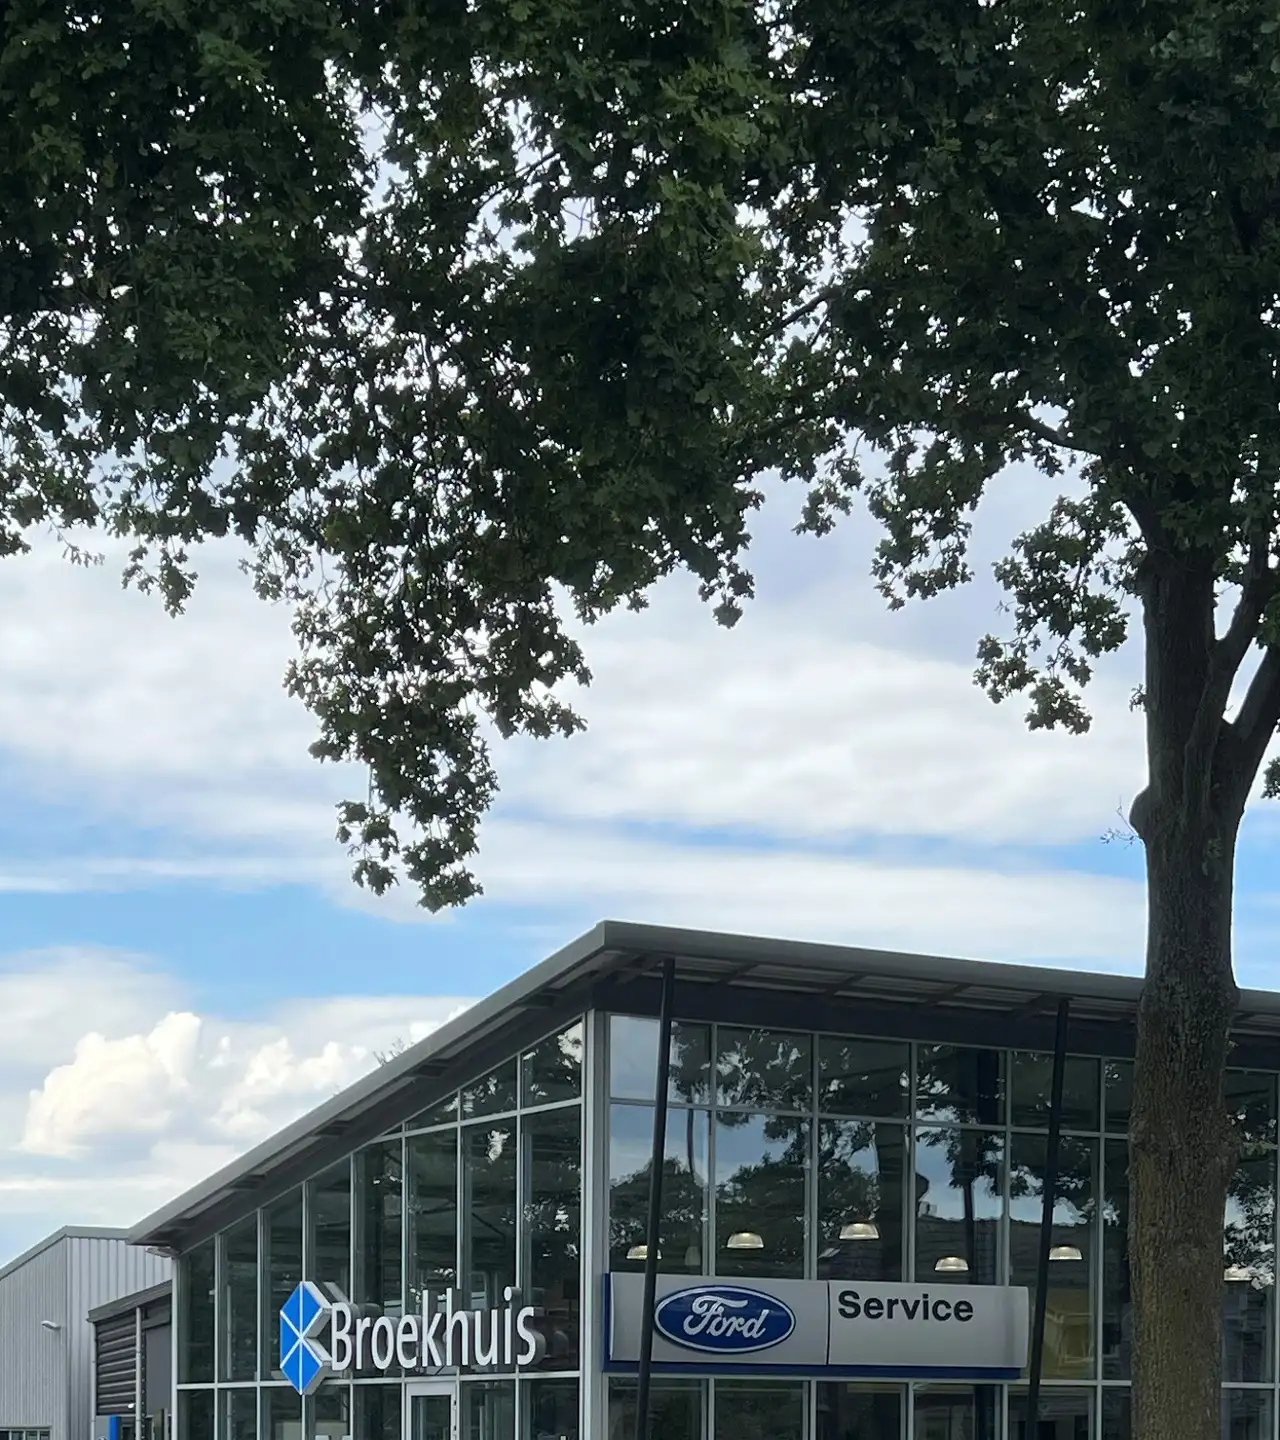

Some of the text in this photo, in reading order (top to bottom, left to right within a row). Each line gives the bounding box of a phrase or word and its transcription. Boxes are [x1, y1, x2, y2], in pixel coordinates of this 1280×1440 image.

[331, 1286, 536, 1371] Broekhuis
[683, 1294, 770, 1339] Ford
[837, 1290, 974, 1322] Service
